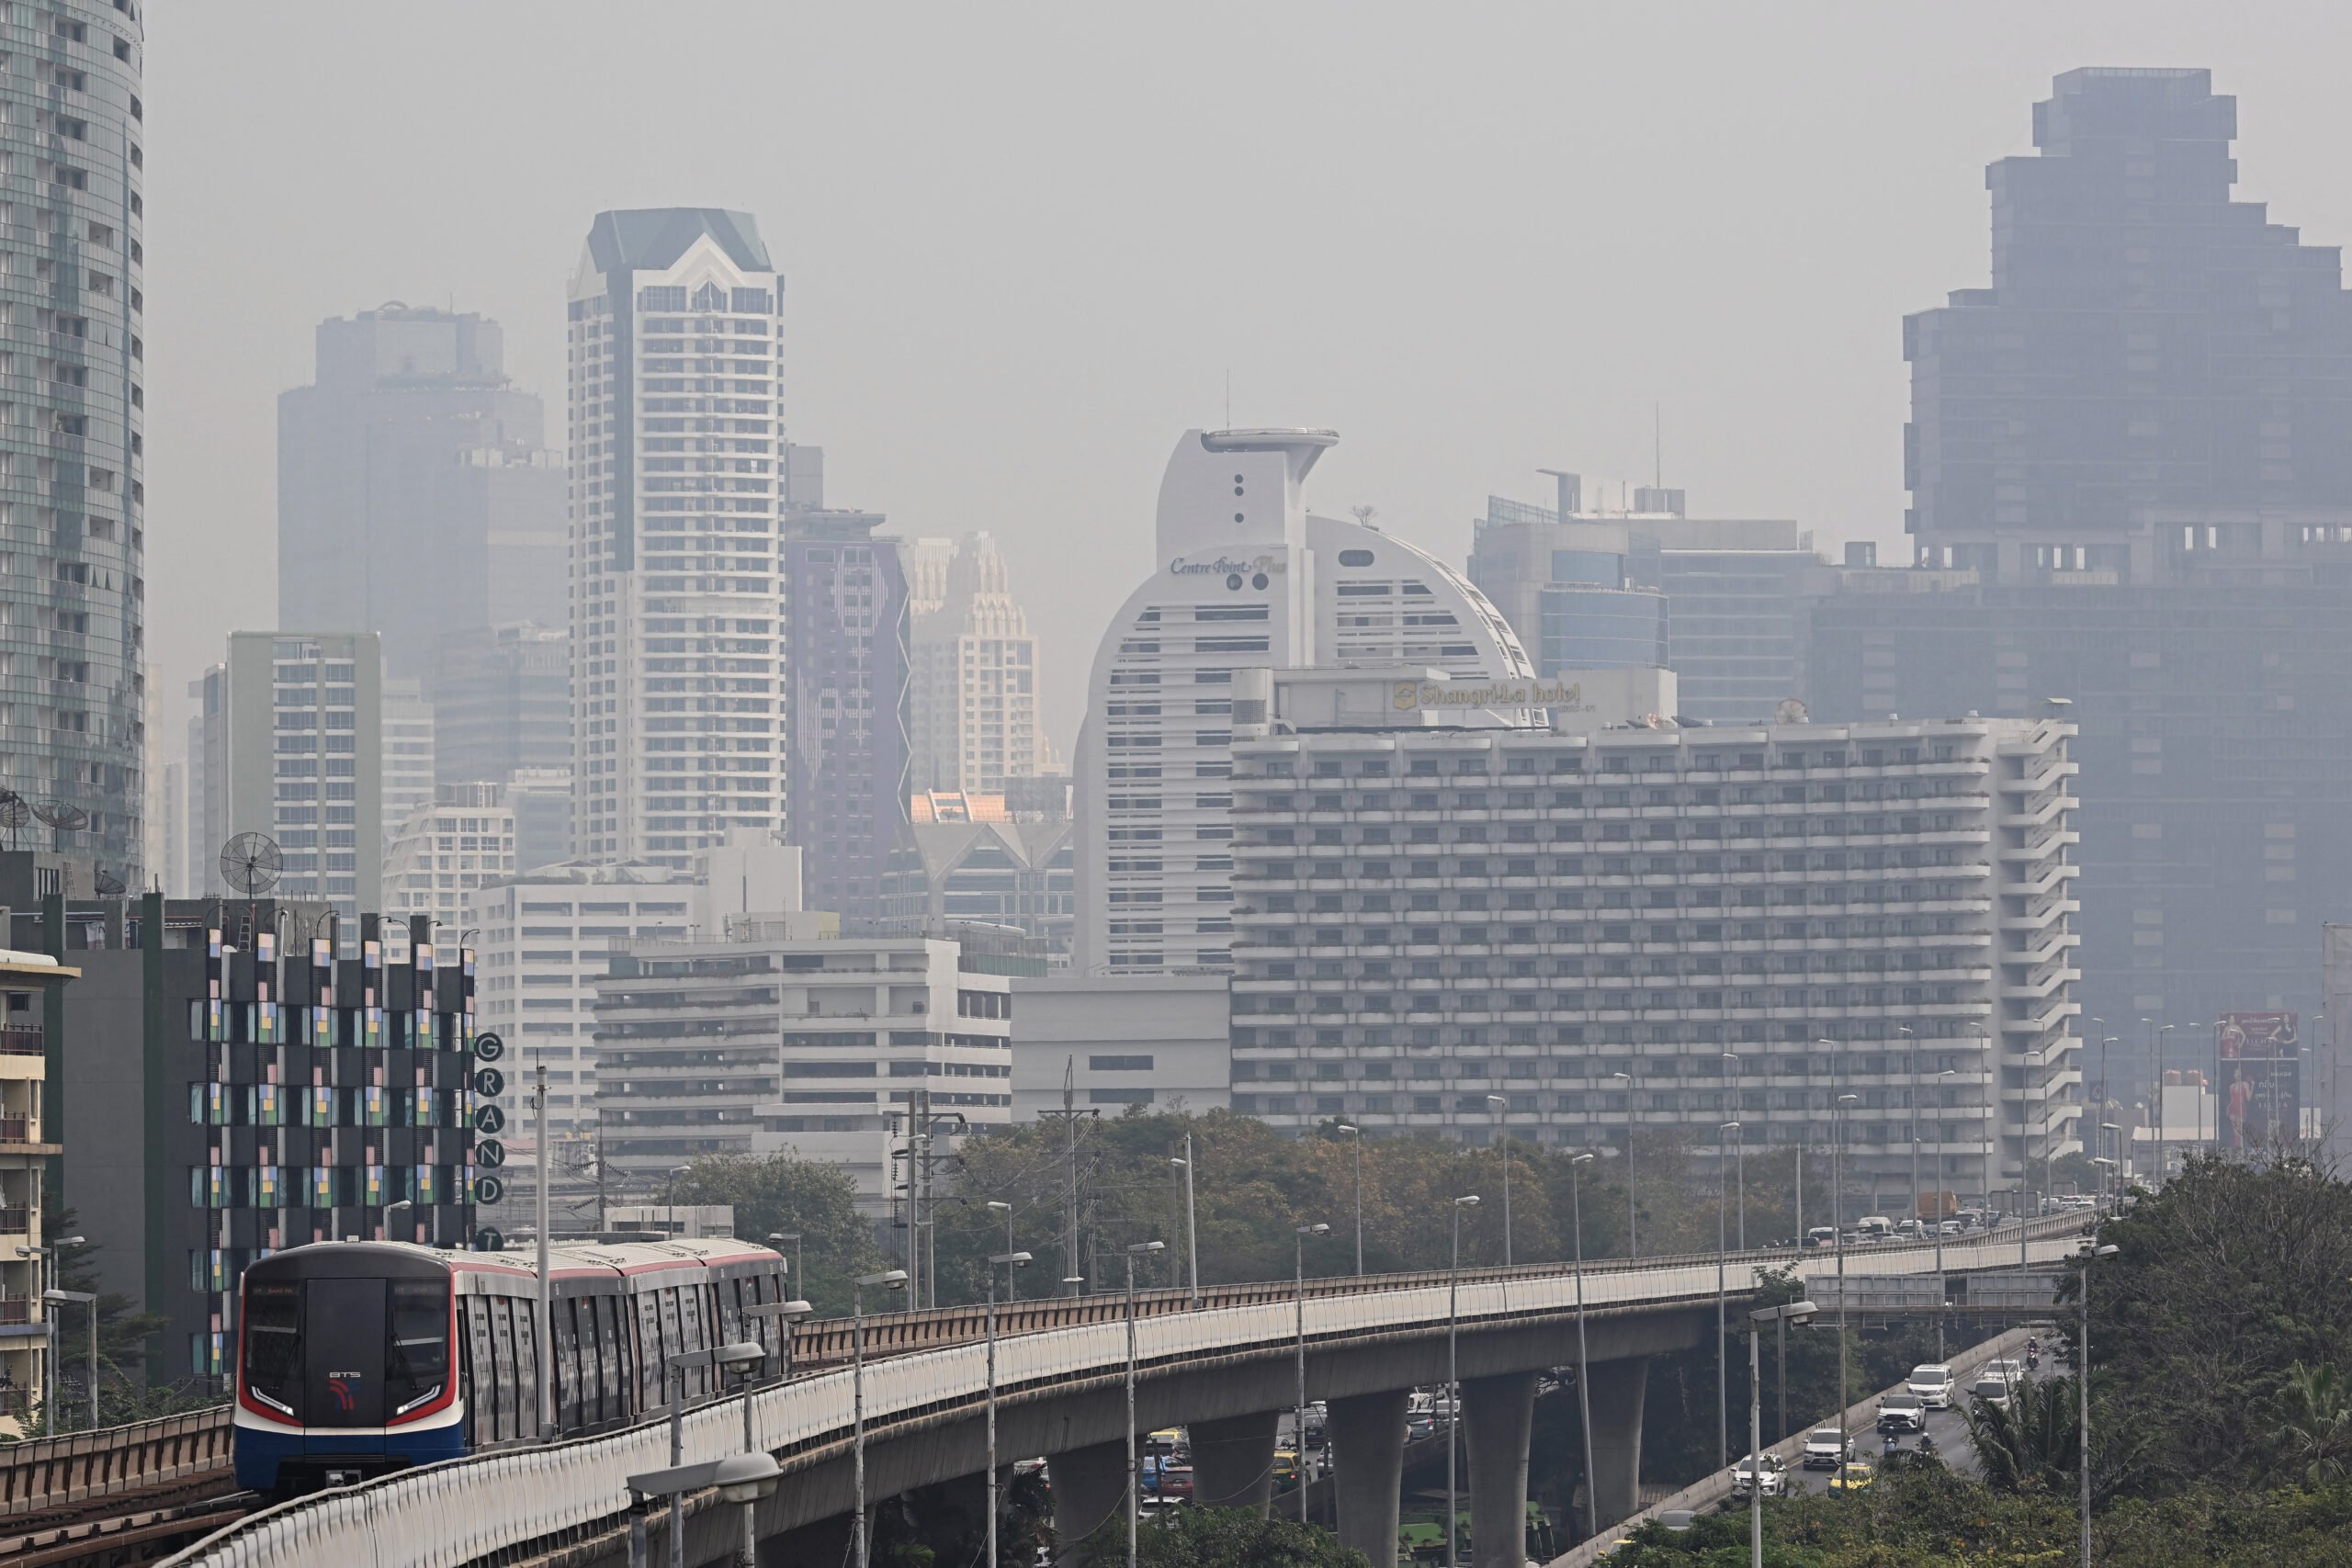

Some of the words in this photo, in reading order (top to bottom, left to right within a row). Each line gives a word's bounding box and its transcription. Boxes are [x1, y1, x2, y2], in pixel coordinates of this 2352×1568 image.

[1170, 557, 1212, 574] Centre
[1213, 556, 1251, 574] Point
[1419, 682, 1526, 708] Shangri-La
[1532, 682, 1581, 704] hotel
[478, 1036, 501, 1201] GRAND
